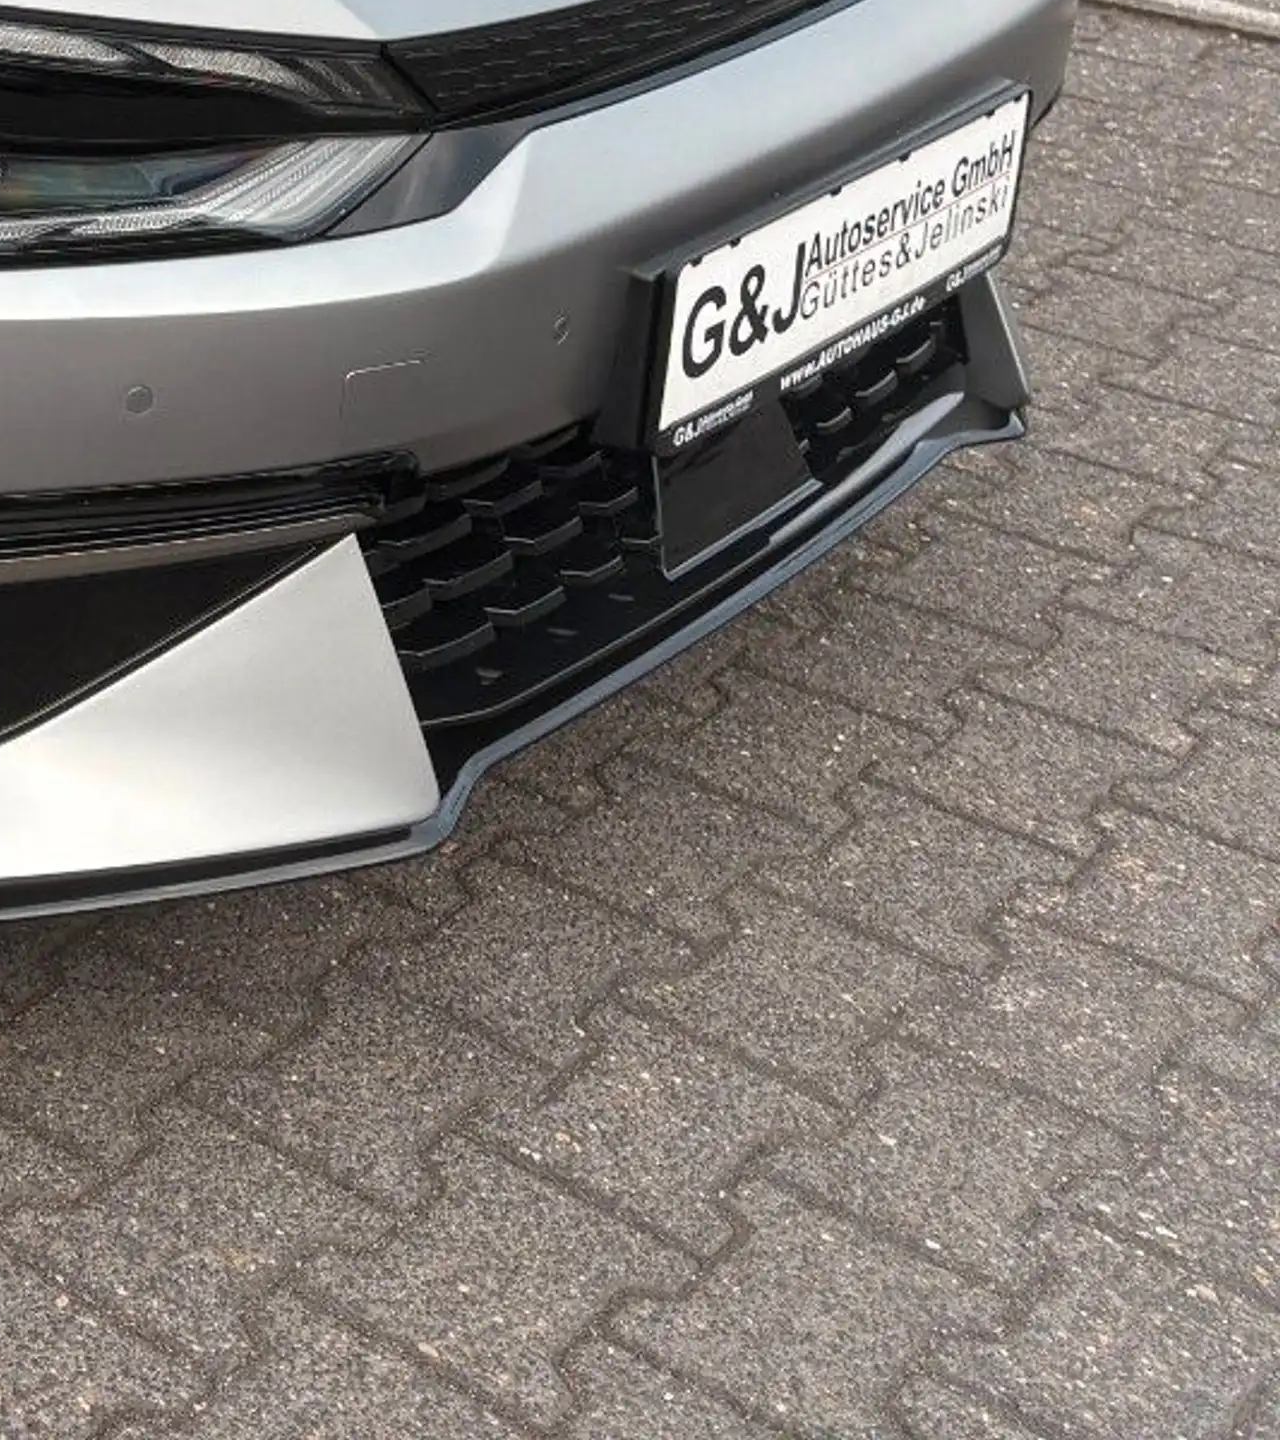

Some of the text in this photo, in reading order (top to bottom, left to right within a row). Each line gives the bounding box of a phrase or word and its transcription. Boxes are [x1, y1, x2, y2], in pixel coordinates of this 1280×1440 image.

[800, 175, 1011, 319] Güttes&Jelinski
[805, 177, 946, 277] Autoservice
[951, 130, 1017, 198] GmbH
[682, 241, 807, 379] G&J
